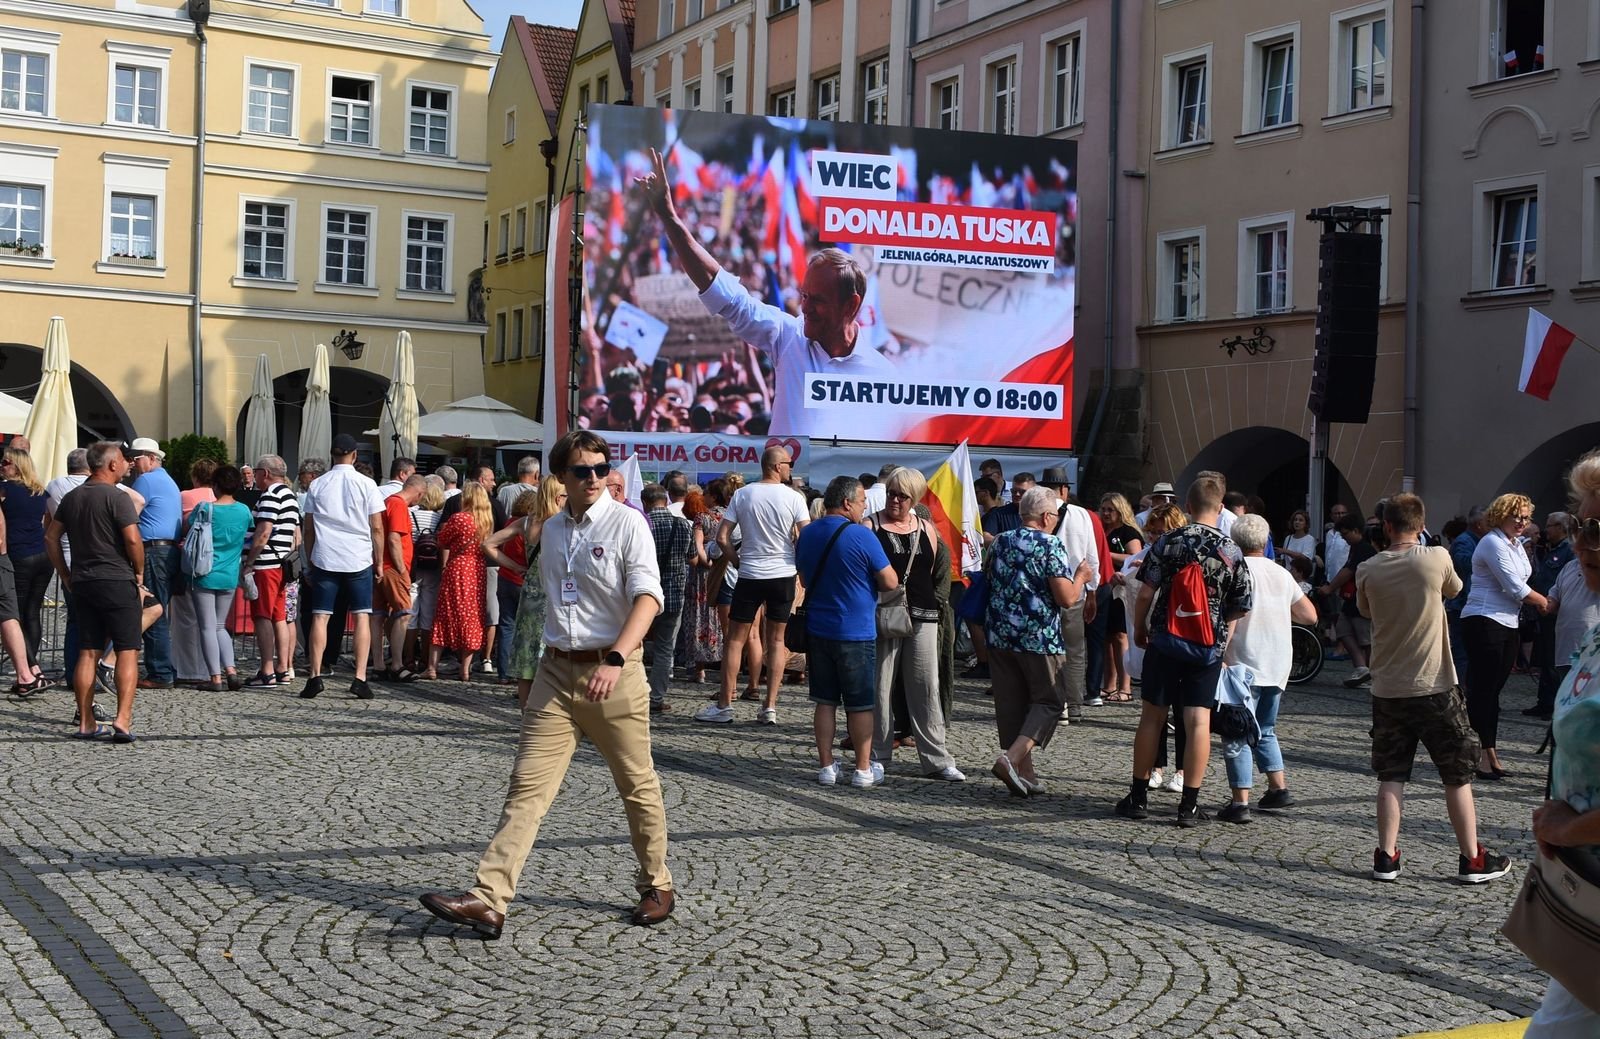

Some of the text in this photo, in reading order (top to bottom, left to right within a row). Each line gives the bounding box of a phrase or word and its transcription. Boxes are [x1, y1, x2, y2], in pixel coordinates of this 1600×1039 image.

[816, 160, 892, 191] WIEC
[824, 206, 1050, 247] DONALDA TUSKA
[880, 249, 1049, 270] JELENIA GÓRA, PLAC RATUSZOWY
[810, 379, 1058, 412] STARTUJEMY O 18:00
[607, 441, 759, 464] ELENIA GÓRA
